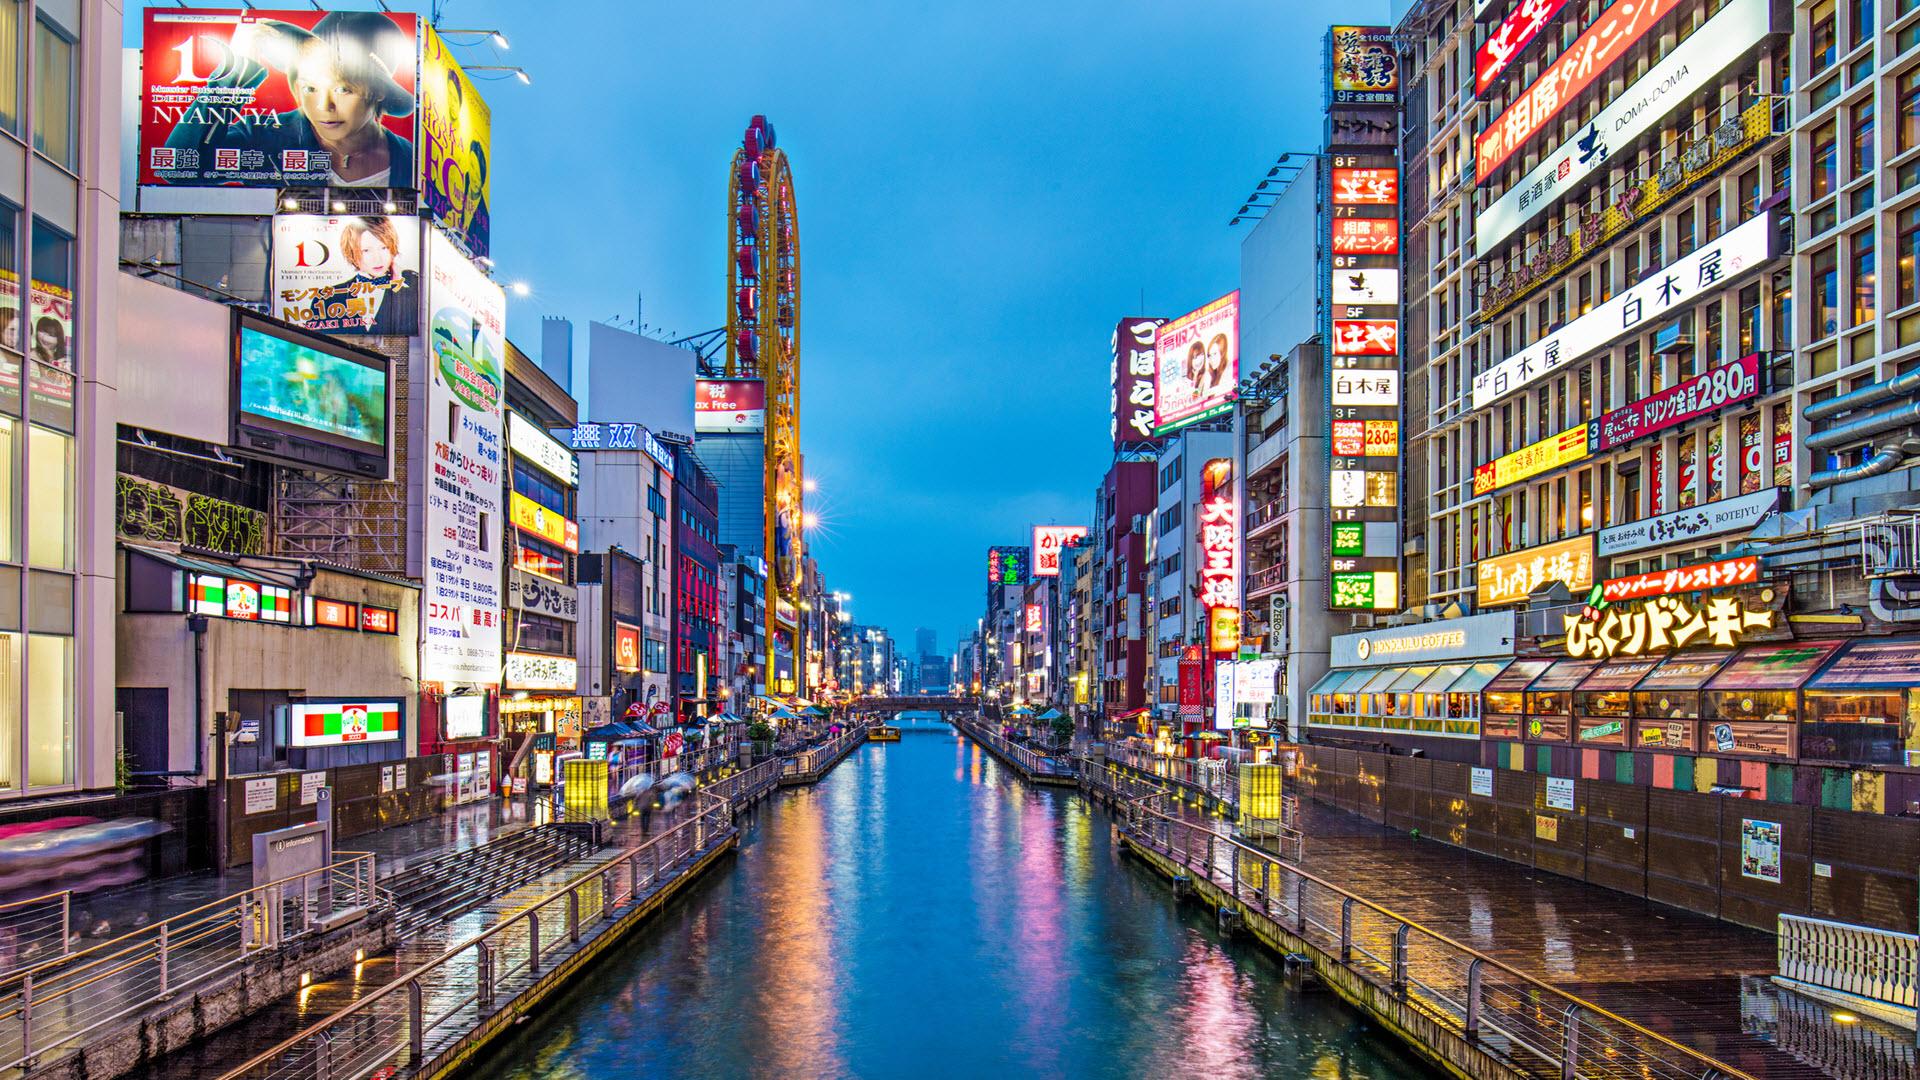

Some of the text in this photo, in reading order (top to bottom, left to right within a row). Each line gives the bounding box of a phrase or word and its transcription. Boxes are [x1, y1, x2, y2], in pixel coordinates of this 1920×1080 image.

[152, 94, 256, 104] DEEP GROUP
[1338, 90, 1394, 102] 9F 全室個室
[152, 106, 282, 126] NYANNYA
[1519, 170, 1556, 211] 居酒家
[1615, 65, 1689, 131] DOMA-DOMA
[151, 148, 332, 172] 最強 最幸 最高
[1343, 221, 1371, 234] 相席
[1334, 236, 1396, 251] ダイニング
[281, 278, 405, 302] モンスターグループ
[1622, 249, 1724, 329] 白木屋
[1347, 308, 1363, 317] 5F
[1163, 324, 1200, 354] 高収入
[1336, 325, 1395, 352] はや
[1476, 339, 1562, 396] 4F 白木屋
[1337, 376, 1392, 394] 白木屋
[1644, 362, 1754, 428] ドリンク全品280円
[695, 400, 736, 409] ax Free
[1367, 430, 1396, 444] 280円
[1602, 534, 1616, 545] 大阪
[1618, 528, 1645, 541] お好み焼
[1715, 506, 1759, 523] BOTEJYU
[1200, 497, 1233, 607] 大阪王将
[1334, 560, 1355, 570] B1F
[1481, 563, 1495, 579] 2F
[1337, 582, 1370, 594] びっくり
[1605, 562, 1756, 598] ハンバーグレストラン
[523, 578, 562, 613] うなぎ
[1335, 593, 1373, 605] ドンキー
[326, 606, 338, 622] 酒
[363, 612, 387, 628] たばこ
[430, 603, 497, 627] コスパ 最高!
[1274, 609, 1282, 630] ZERO
[1564, 597, 1772, 659] びっくりドンキー
[622, 637, 632, 658] G3
[1373, 631, 1464, 654] HONOLULU COFFEE
[286, 836, 315, 849] information
